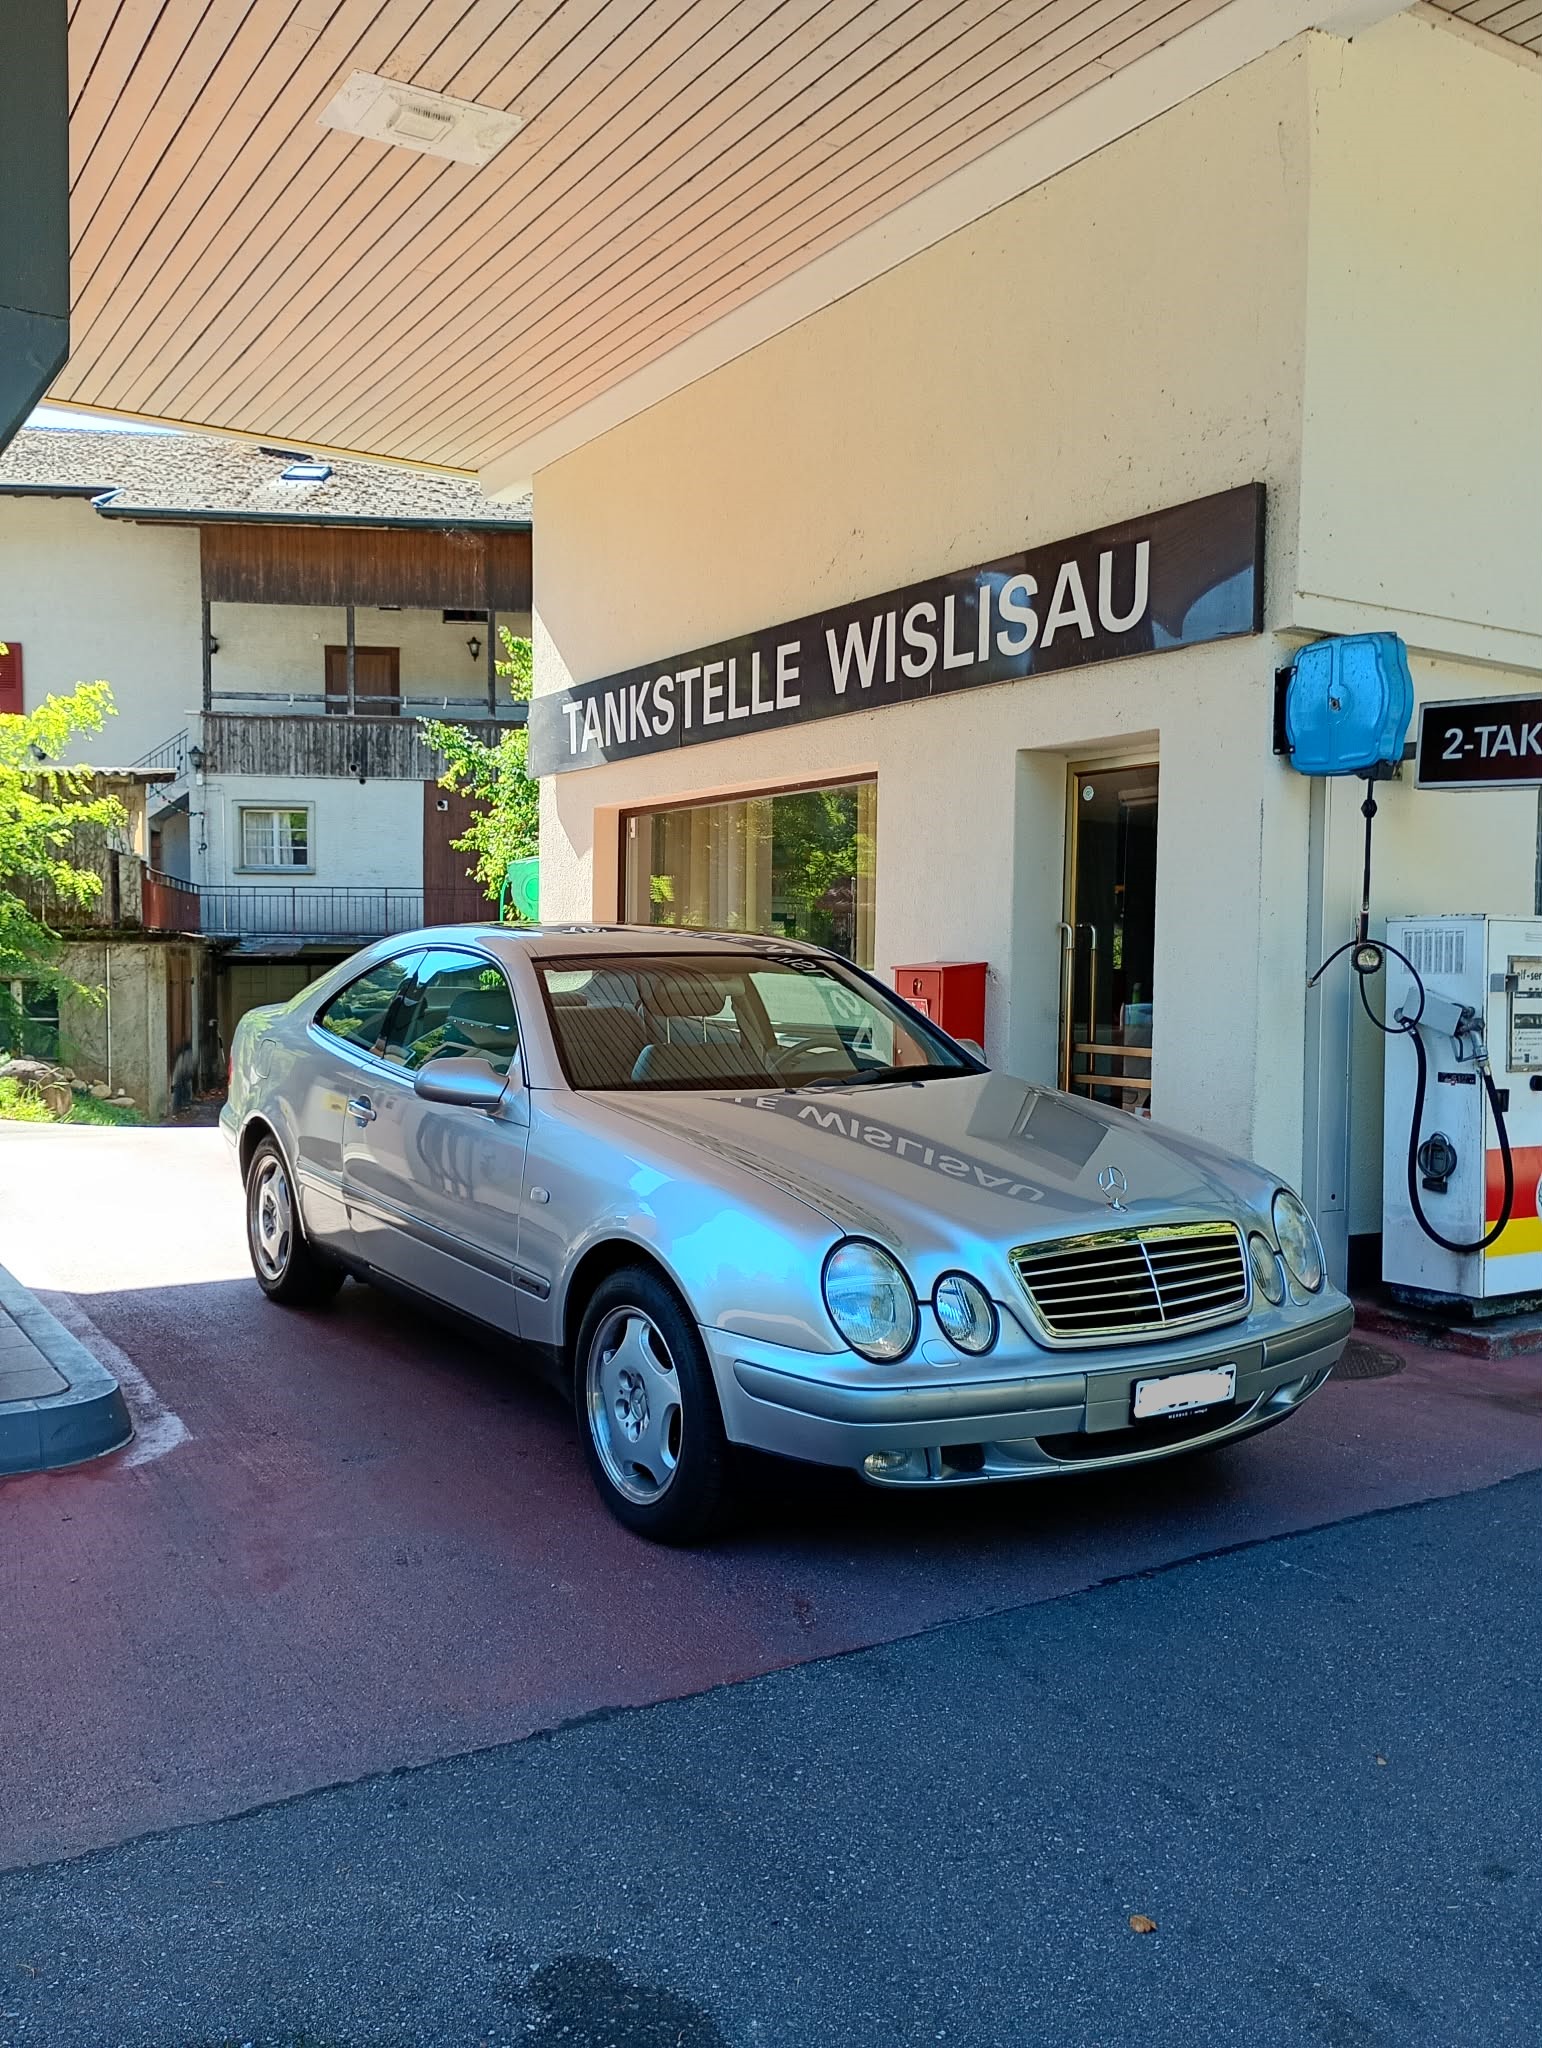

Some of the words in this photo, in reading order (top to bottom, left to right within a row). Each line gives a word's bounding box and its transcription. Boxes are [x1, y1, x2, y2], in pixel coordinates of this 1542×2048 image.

[562, 640, 801, 755] TANKSTELLE
[825, 540, 1151, 695] WISLISAU
[1442, 722, 1542, 760] 2-TAK
